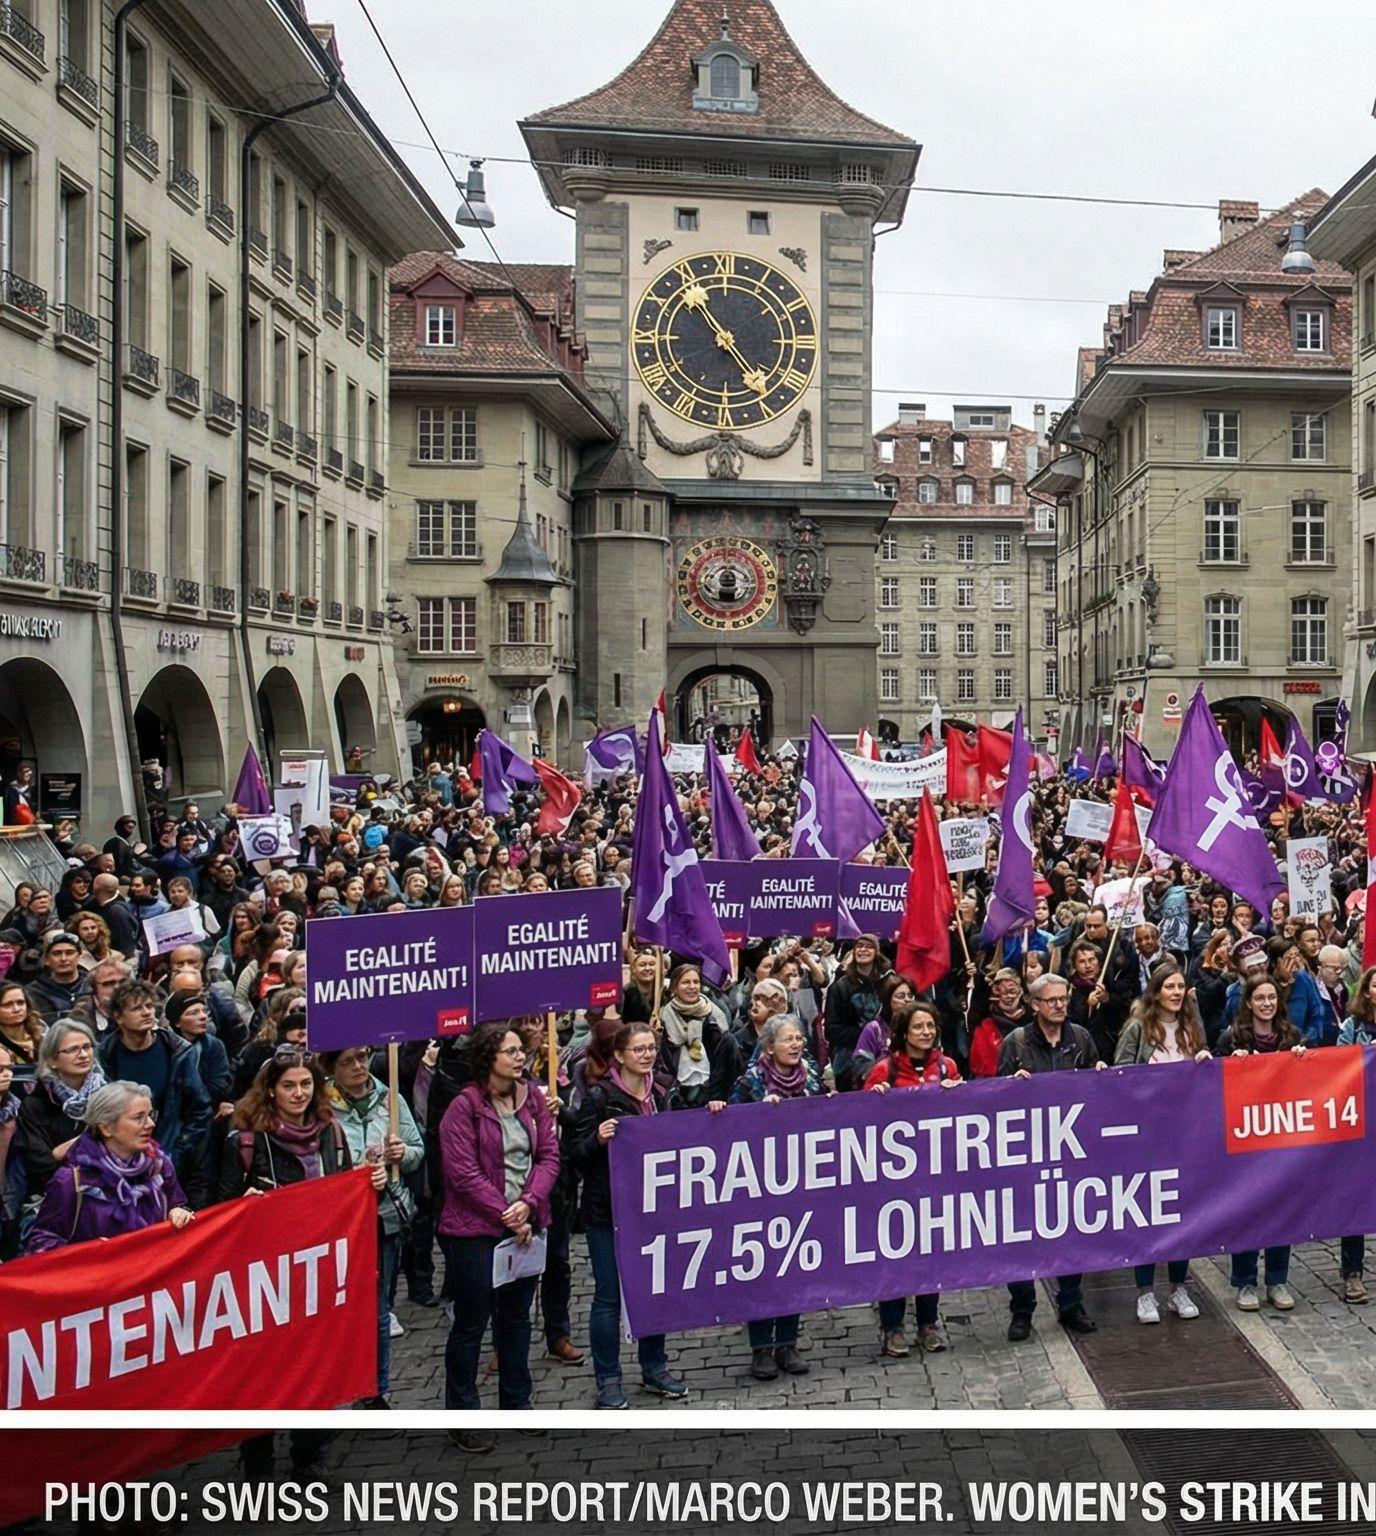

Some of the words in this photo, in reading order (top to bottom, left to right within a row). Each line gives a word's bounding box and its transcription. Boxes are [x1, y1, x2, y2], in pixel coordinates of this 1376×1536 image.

[762, 875, 815, 893] EGALITÉ
[508, 914, 589, 946] EGALITÉ
[346, 937, 437, 972] EGALITÉ
[481, 942, 618, 975] MAINTENANT!
[314, 966, 468, 1004] MAINTENANT!
[1233, 1098, 1313, 1138] JUNE
[1324, 1096, 1359, 1128] 14
[641, 1102, 1086, 1215] FRAUENSTREIK
[641, 1210, 822, 1295] 17.5%
[843, 1168, 1181, 1266] LOHNLÜCKE
[7, 1238, 348, 1410] NTENANT!
